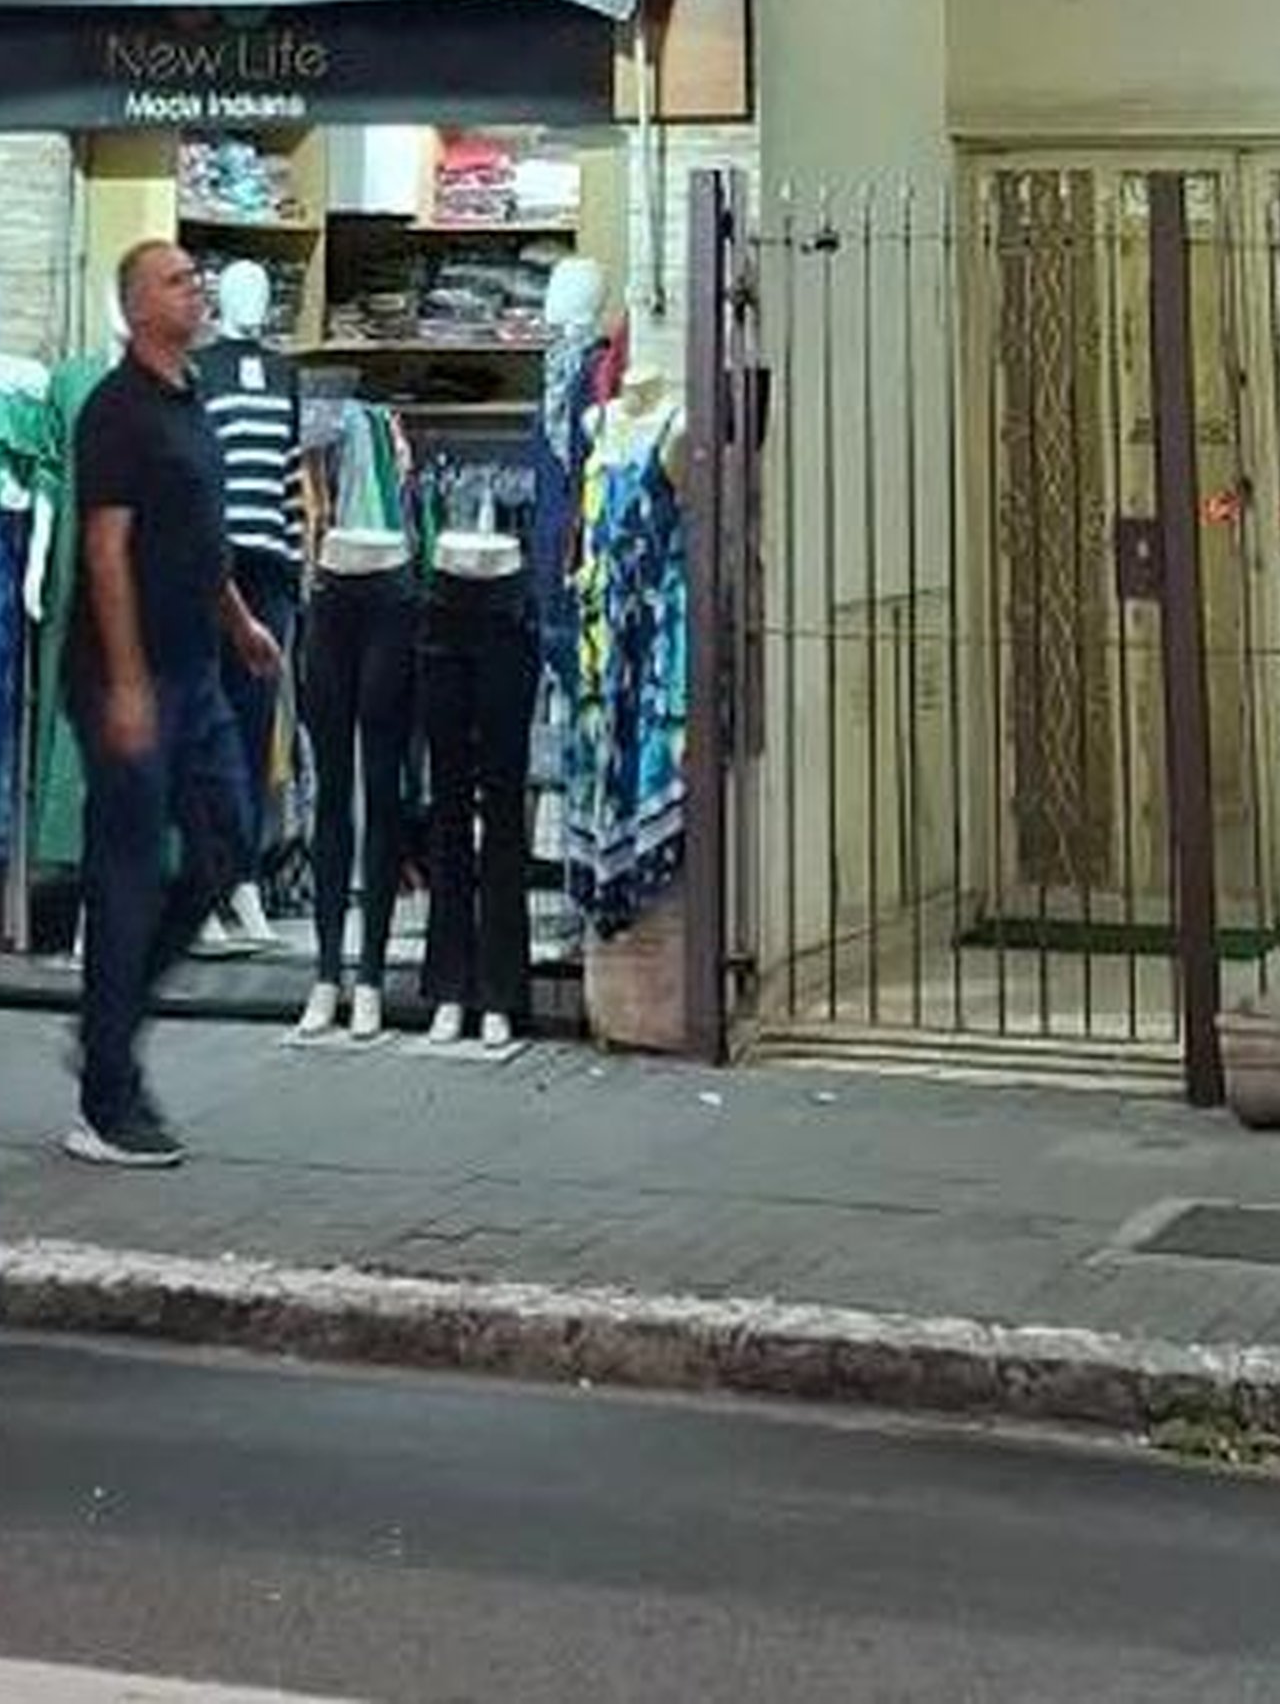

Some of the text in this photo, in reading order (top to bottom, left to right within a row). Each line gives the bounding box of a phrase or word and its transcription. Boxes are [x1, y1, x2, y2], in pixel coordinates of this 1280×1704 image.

[107, 32, 330, 80] New Life
[125, 89, 201, 121] Moda
